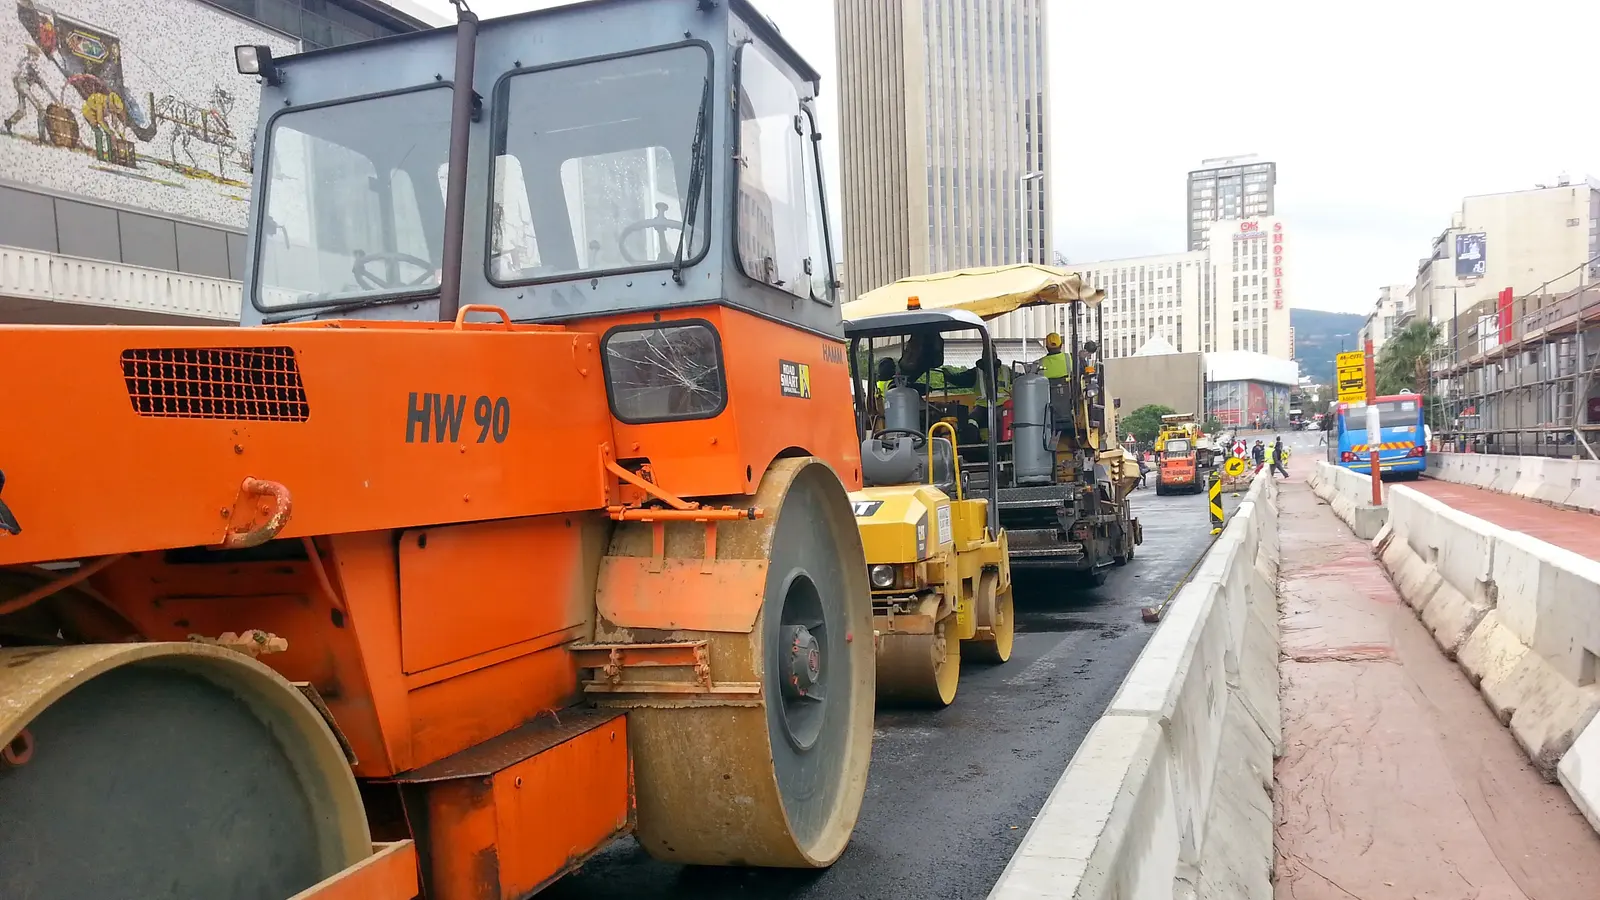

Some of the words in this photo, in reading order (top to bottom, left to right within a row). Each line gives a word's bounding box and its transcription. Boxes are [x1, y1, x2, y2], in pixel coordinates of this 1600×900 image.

[1240, 221, 1258, 232] OK
[1273, 222, 1283, 309] SHOPRITE
[783, 364, 795, 375] ROAD
[781, 374, 798, 388] SMART
[405, 392, 467, 443] HW
[474, 395, 511, 443] 90
